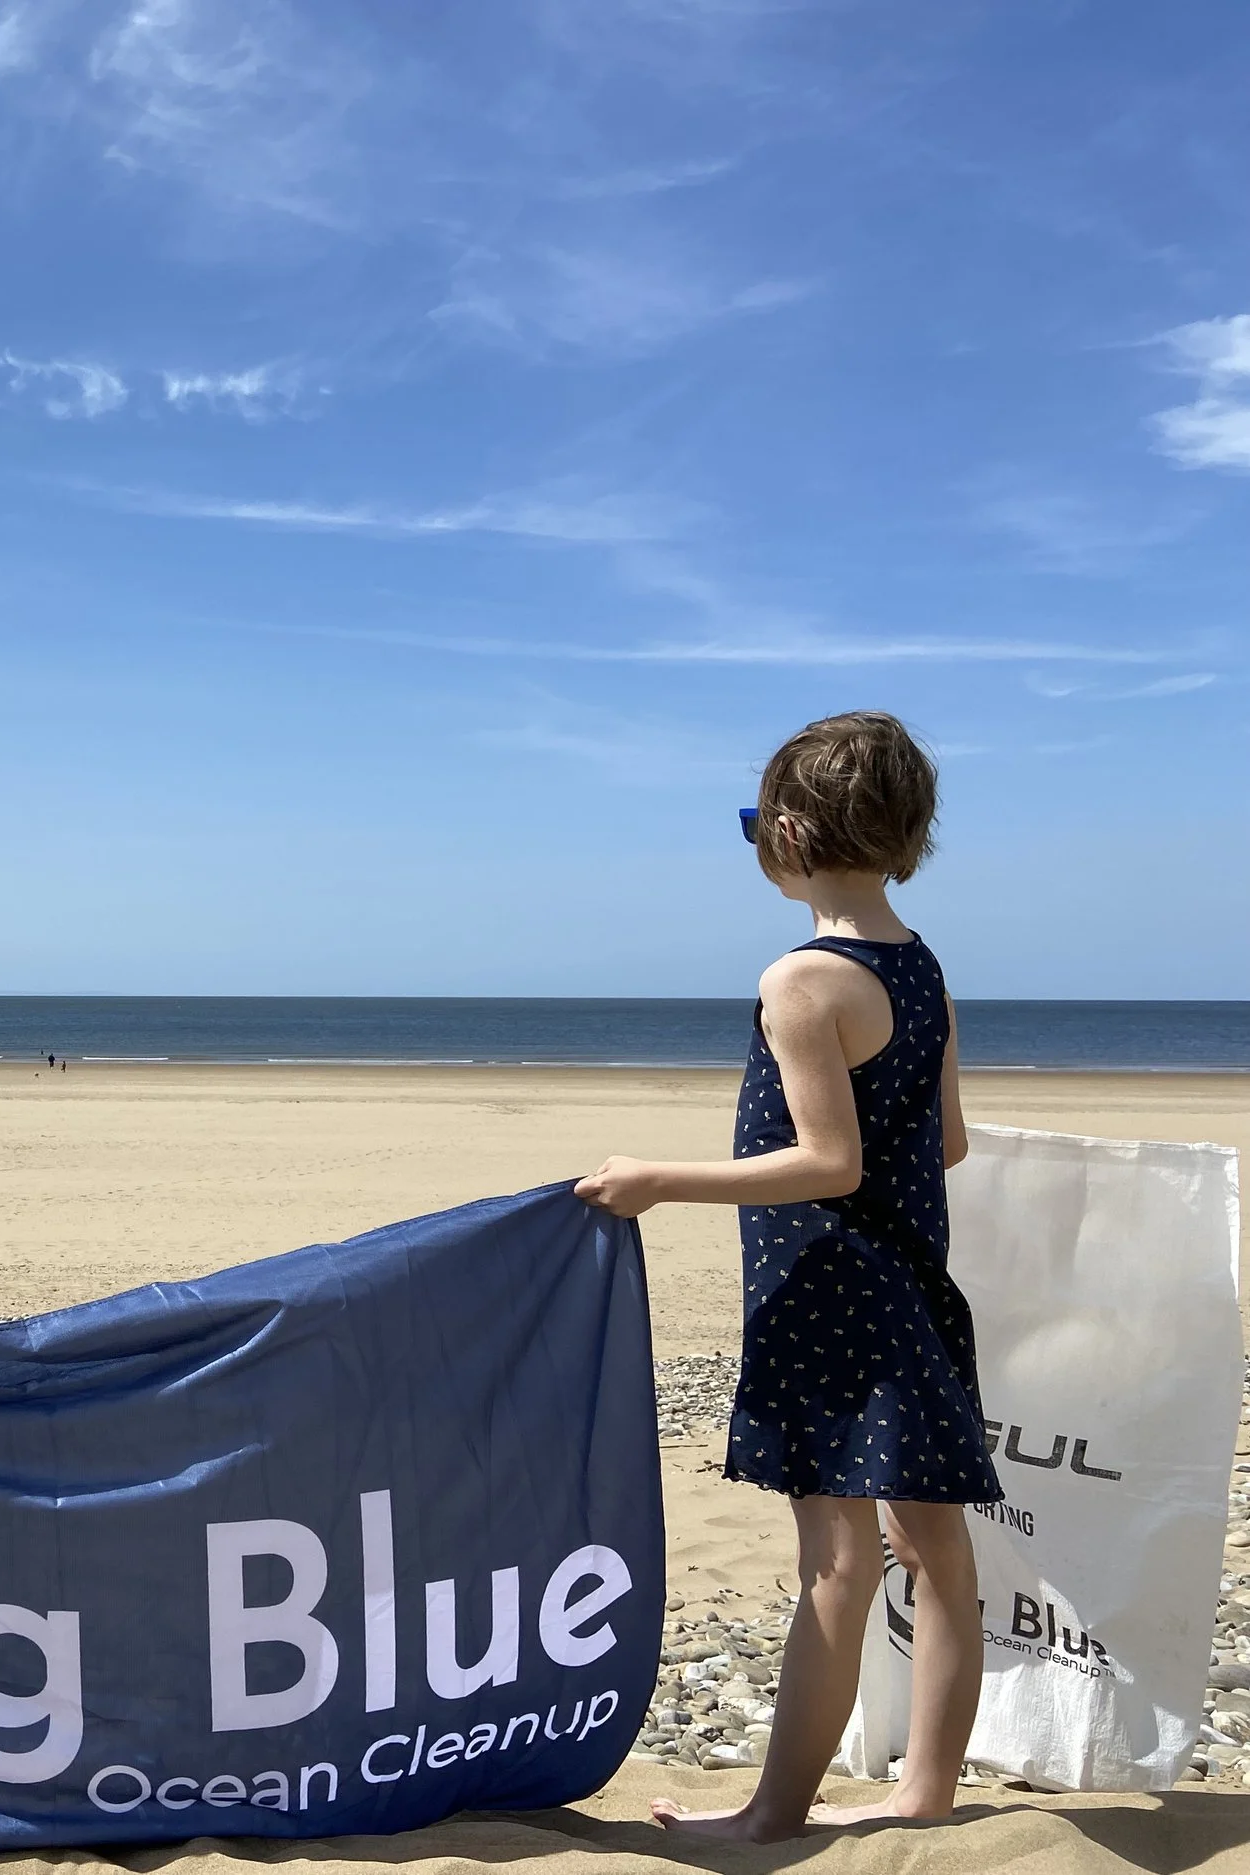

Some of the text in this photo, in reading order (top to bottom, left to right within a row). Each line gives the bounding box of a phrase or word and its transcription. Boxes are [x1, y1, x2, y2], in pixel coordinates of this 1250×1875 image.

[207, 1489, 632, 1732] Blue
[983, 1630, 1032, 1655] Ocean
[1037, 1646, 1102, 1679] Cleanup
[1011, 1591, 1110, 1666] Blue
[87, 1689, 619, 1813] Ocean Cleanup
